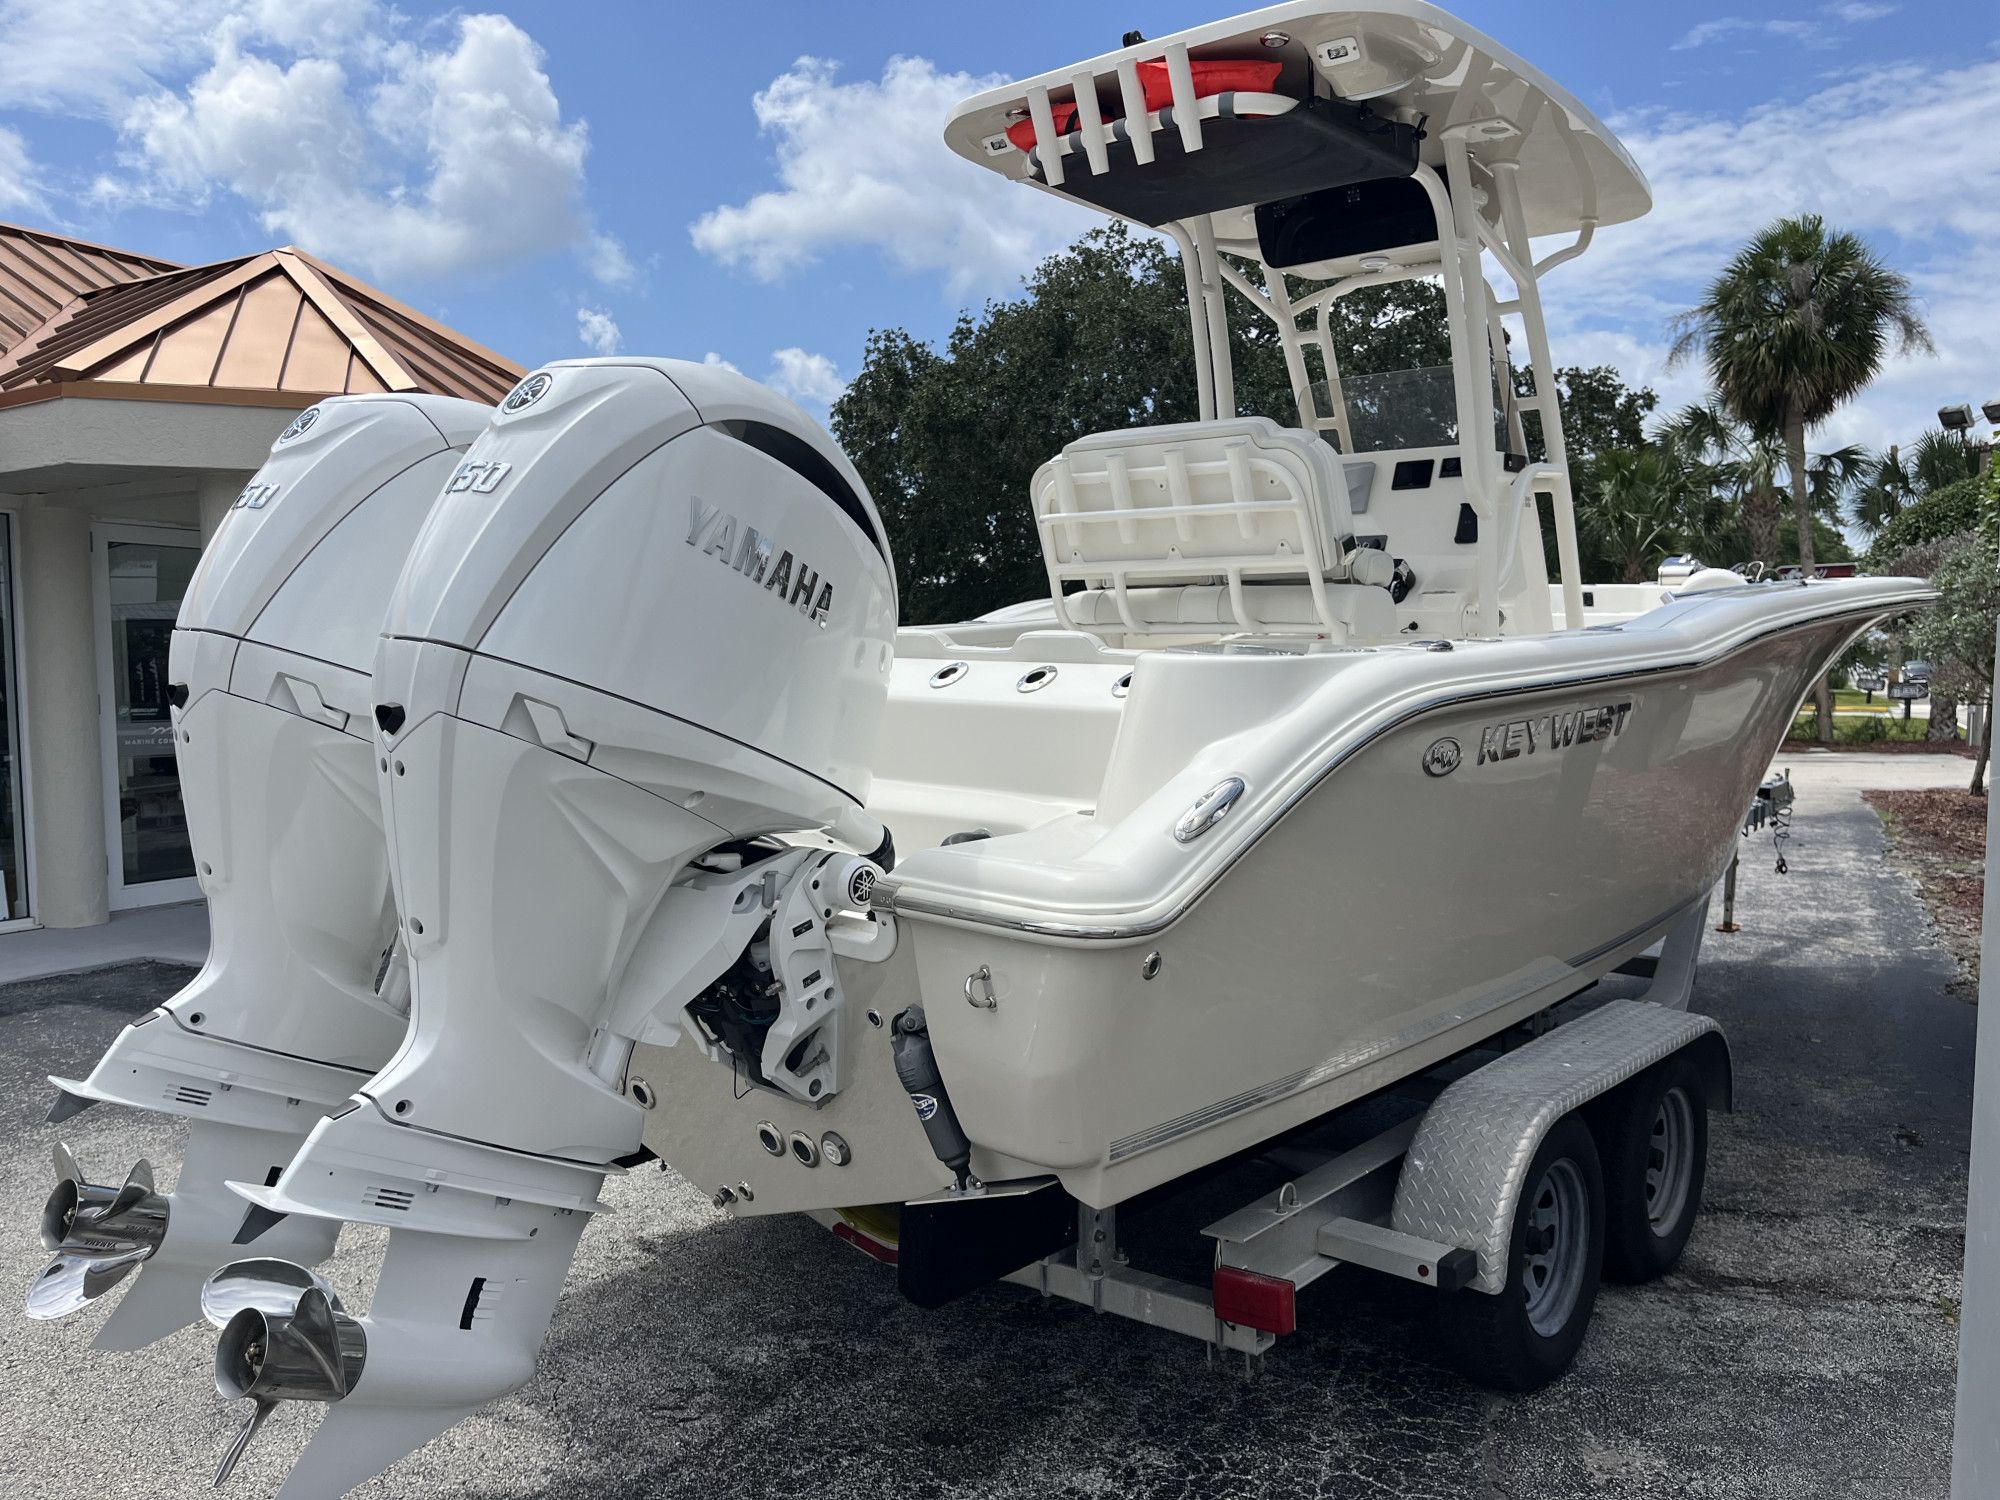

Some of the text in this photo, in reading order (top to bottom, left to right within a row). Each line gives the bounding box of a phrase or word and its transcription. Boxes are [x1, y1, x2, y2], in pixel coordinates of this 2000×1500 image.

[685, 495, 834, 630] YAMAHA
[1477, 702, 1632, 766] KEY WEST
